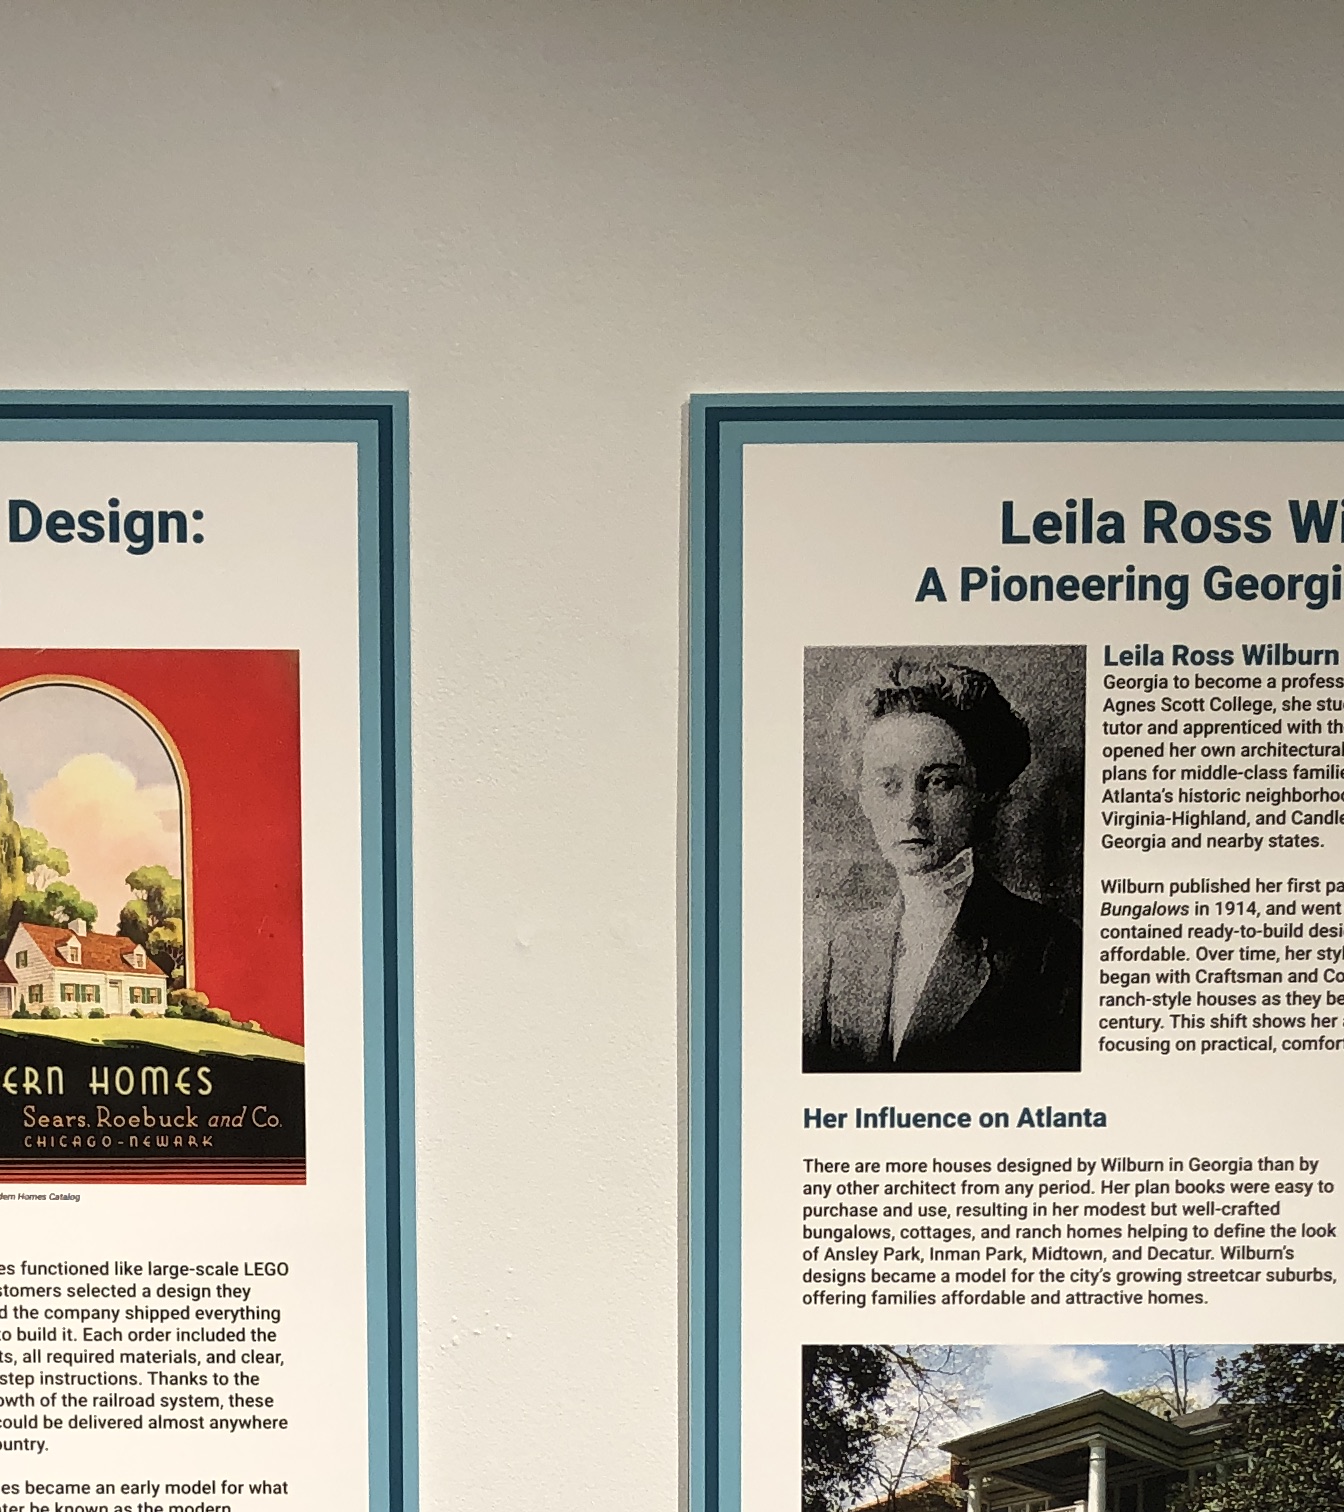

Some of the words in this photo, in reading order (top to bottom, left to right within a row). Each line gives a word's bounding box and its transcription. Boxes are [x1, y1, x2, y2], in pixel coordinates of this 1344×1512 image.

[9, 497, 204, 555] Design:
[1002, 498, 1125, 544] Leila
[1144, 500, 1272, 544] Ross
[915, 567, 947, 602] A
[961, 564, 1189, 611] Pioneering
[1104, 643, 1164, 666] Leila
[1172, 644, 1234, 666] Ross
[1242, 643, 1339, 666] Wilburn
[1098, 1036, 1170, 1055] focusing
[1175, 1040, 1196, 1051] on
[1201, 1036, 1277, 1055] practical,
[89, 1066, 213, 1095] HOMES
[97, 1105, 199, 1129] Roebuck
[207, 1105, 247, 1128] and
[251, 1105, 284, 1130] Co.
[804, 1108, 848, 1128] Her
[856, 1106, 972, 1128] Influence
[979, 1112, 1009, 1128] on
[1016, 1106, 1107, 1128] Atlanta
[803, 1158, 850, 1173] There
[855, 1162, 880, 1173] are
[886, 1162, 928, 1173] more
[933, 1158, 992, 1173] houses
[997, 1157, 1072, 1176] designed
[1077, 1157, 1097, 1176] by
[1101, 1157, 1164, 1172] Wilburn
[1169, 1157, 1184, 1171] in
[1189, 1157, 1253, 1175] Georgia
[1257, 1156, 1294, 1171] than
[1299, 1156, 1319, 1175] by
[49, 1193, 80, 1202] Catalog
[20, 1260, 109, 1276] functioned
[115, 1261, 143, 1276] like
[148, 1261, 239, 1280] large-scale
[244, 1262, 289, 1276] LEGO
